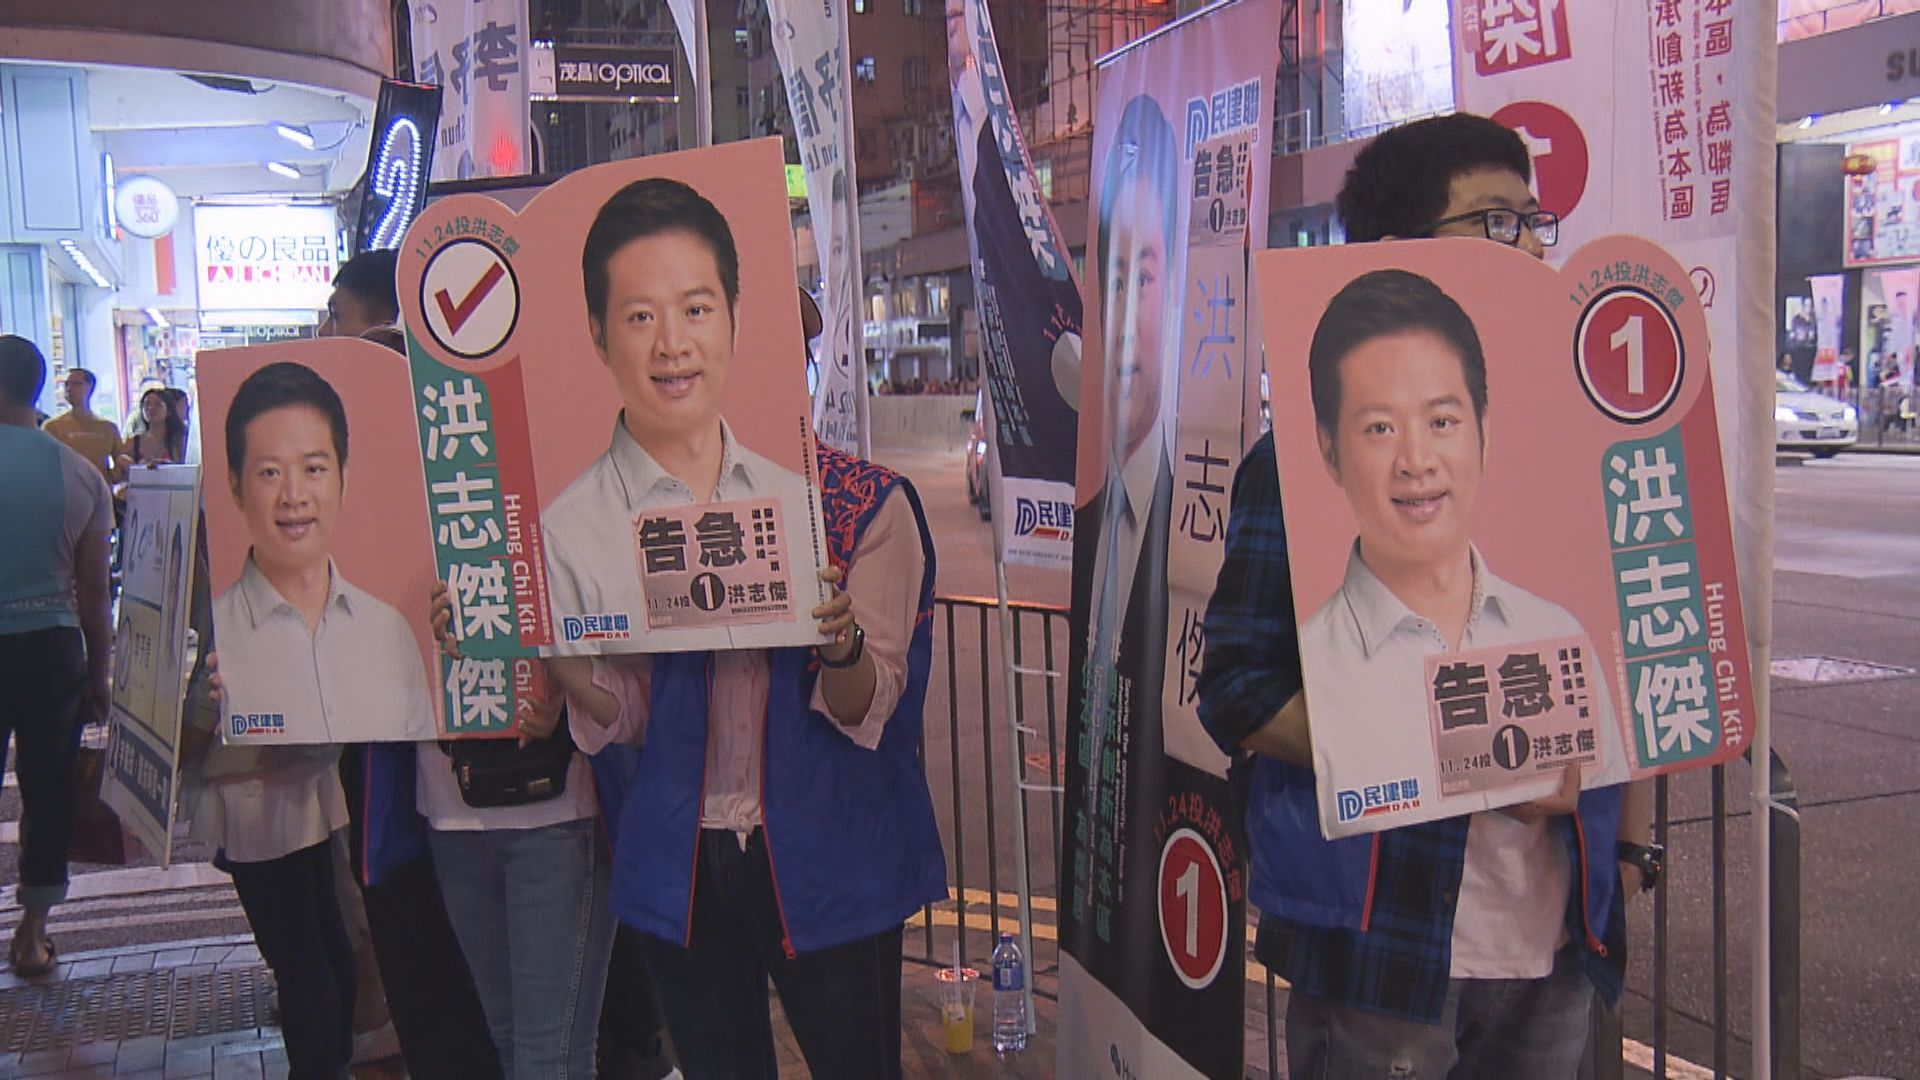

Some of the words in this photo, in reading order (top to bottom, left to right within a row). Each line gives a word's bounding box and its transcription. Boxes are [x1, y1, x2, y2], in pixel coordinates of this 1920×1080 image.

[207, 235, 329, 262] 優の良品
[423, 378, 513, 641] 洪志傑
[504, 494, 524, 555] Hung
[639, 511, 748, 573] 告急
[513, 561, 532, 596] Chi
[728, 580, 788, 605] 洪志傑
[518, 604, 537, 635] Kit
[1609, 447, 1713, 759] 洪志傑
[1705, 582, 1728, 653] Hung
[446, 658, 509, 728] 傑
[514, 660, 533, 692] Chi
[1433, 652, 1555, 731] 告急
[1716, 660, 1739, 702] Chi
[1722, 709, 1745, 746] Kit
[1440, 753, 1492, 773] 11.24投
[1533, 728, 1596, 759] 洪志傑
